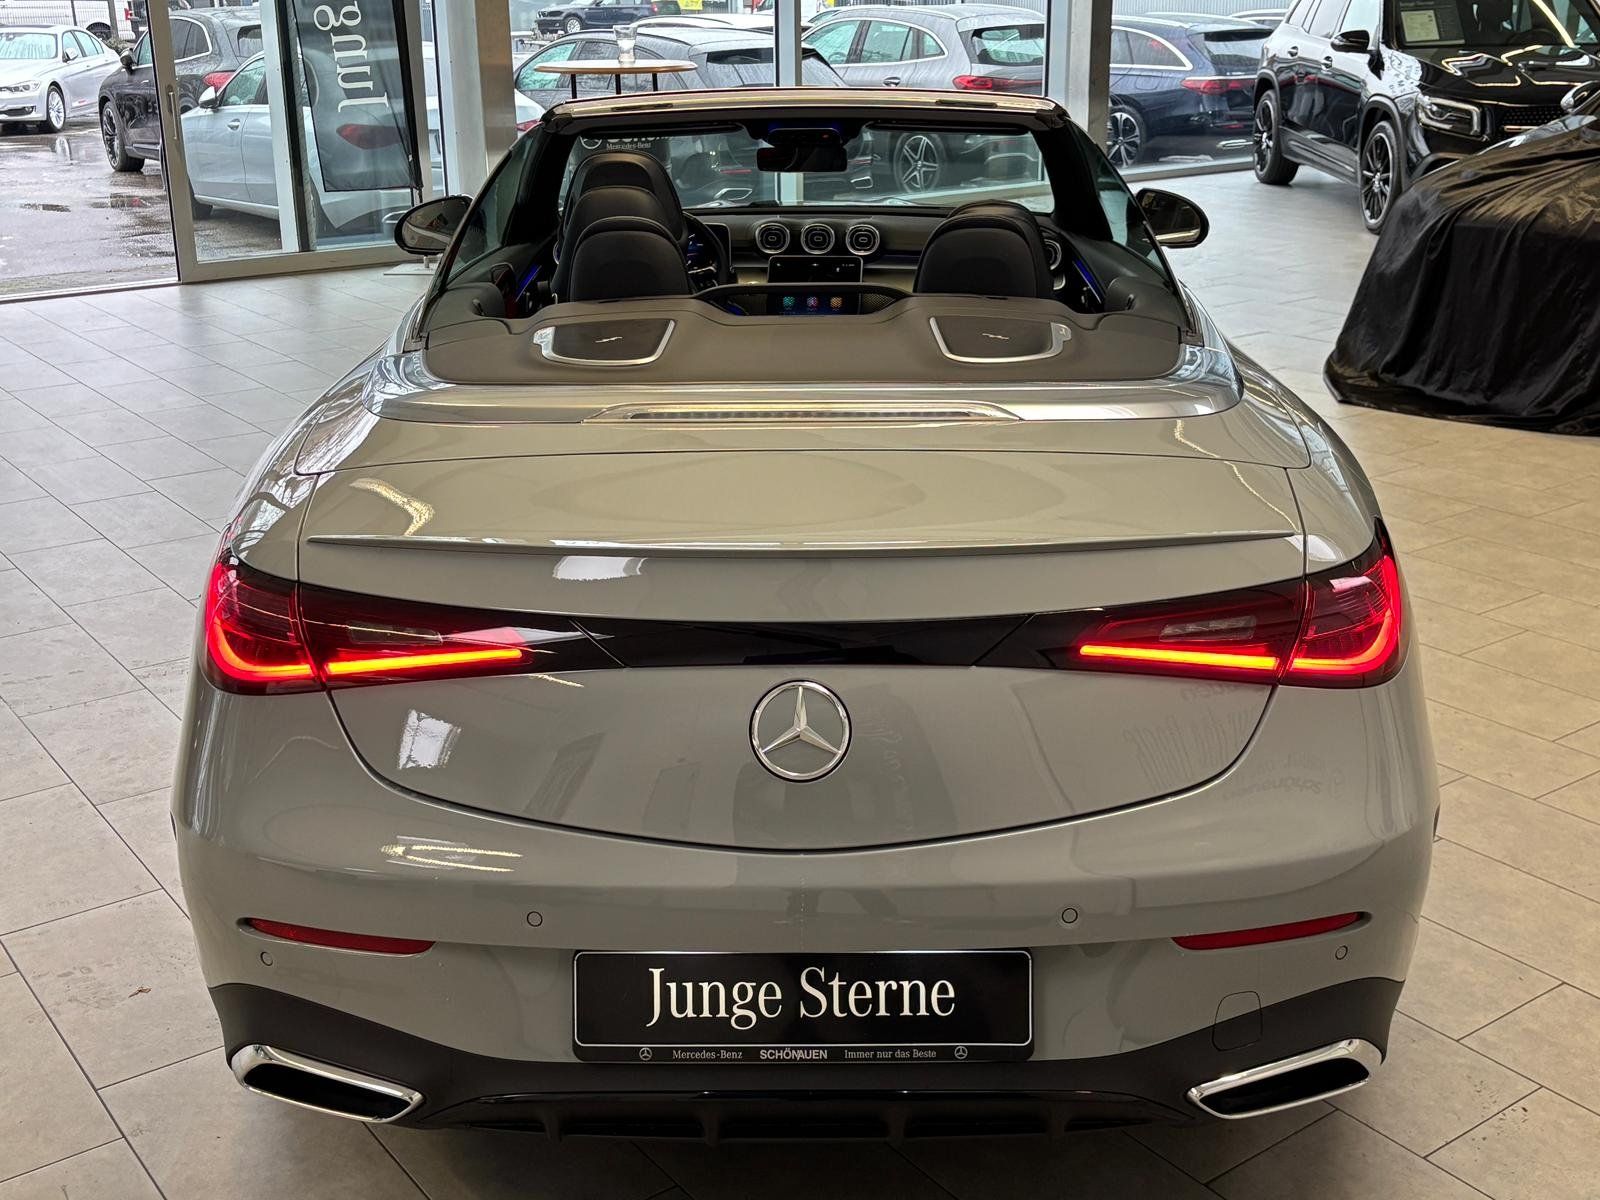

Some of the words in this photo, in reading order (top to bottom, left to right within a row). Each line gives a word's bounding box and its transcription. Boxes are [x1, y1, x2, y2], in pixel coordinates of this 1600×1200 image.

[646, 967, 783, 1030] Junge
[799, 966, 956, 1019] Sterne
[672, 1049, 743, 1060] Mercedes-Benz
[759, 1048, 828, 1060] SCHÖNAUEN
[844, 1049, 874, 1059] Immer
[876, 1051, 893, 1059] nur
[895, 1049, 911, 1058] das
[912, 1049, 937, 1058] Beste
